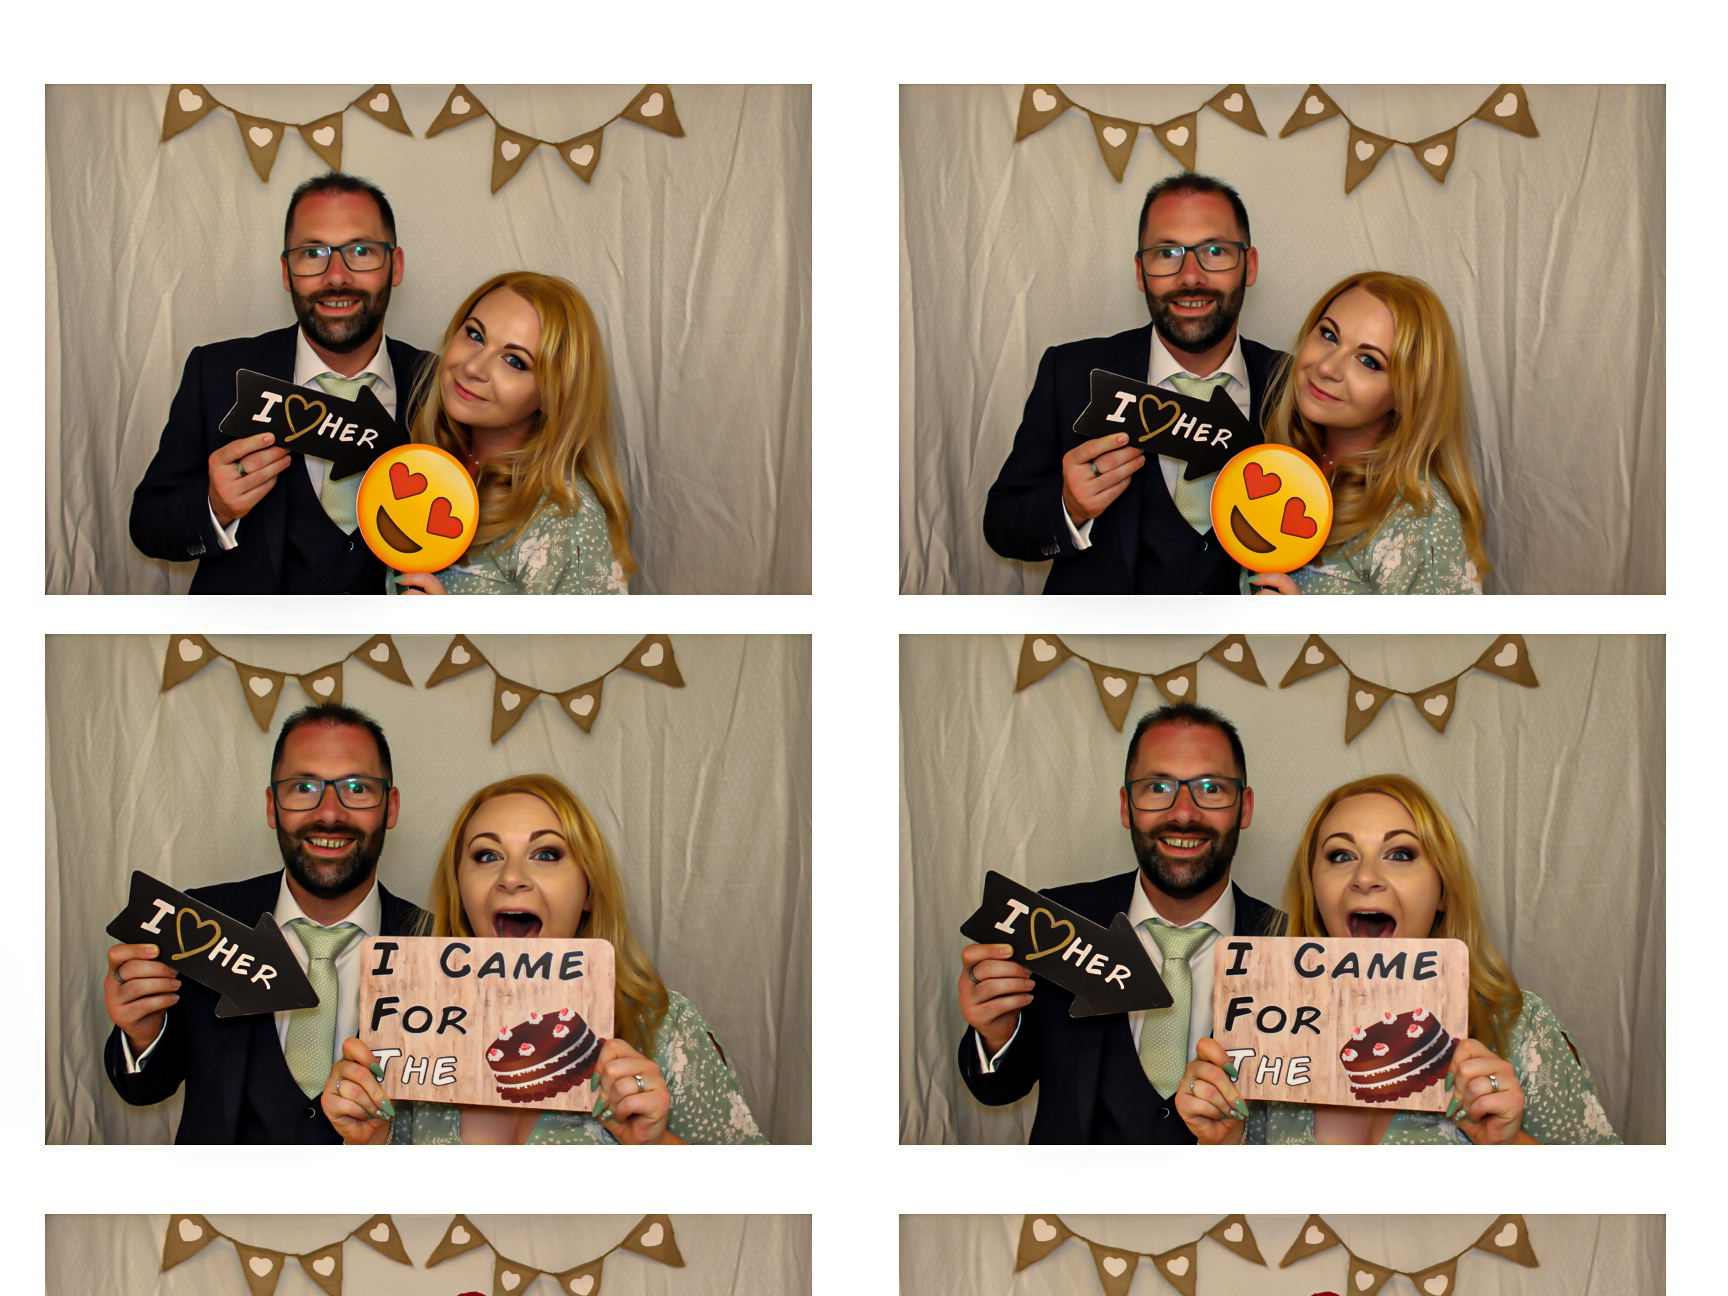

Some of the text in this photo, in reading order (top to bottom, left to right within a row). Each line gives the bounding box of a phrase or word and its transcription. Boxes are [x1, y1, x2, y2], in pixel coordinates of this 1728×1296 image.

[251, 391, 379, 449] I HER
[1105, 391, 1233, 449] I HER
[140, 898, 278, 990] I HER
[371, 942, 584, 981] I CAME
[994, 898, 1132, 990] I HER
[1225, 942, 1438, 981] I CAME
[370, 996, 468, 1035] FOR
[1224, 996, 1322, 1035] FOR
[370, 1048, 457, 1086] THE
[1224, 1048, 1311, 1086] THE
